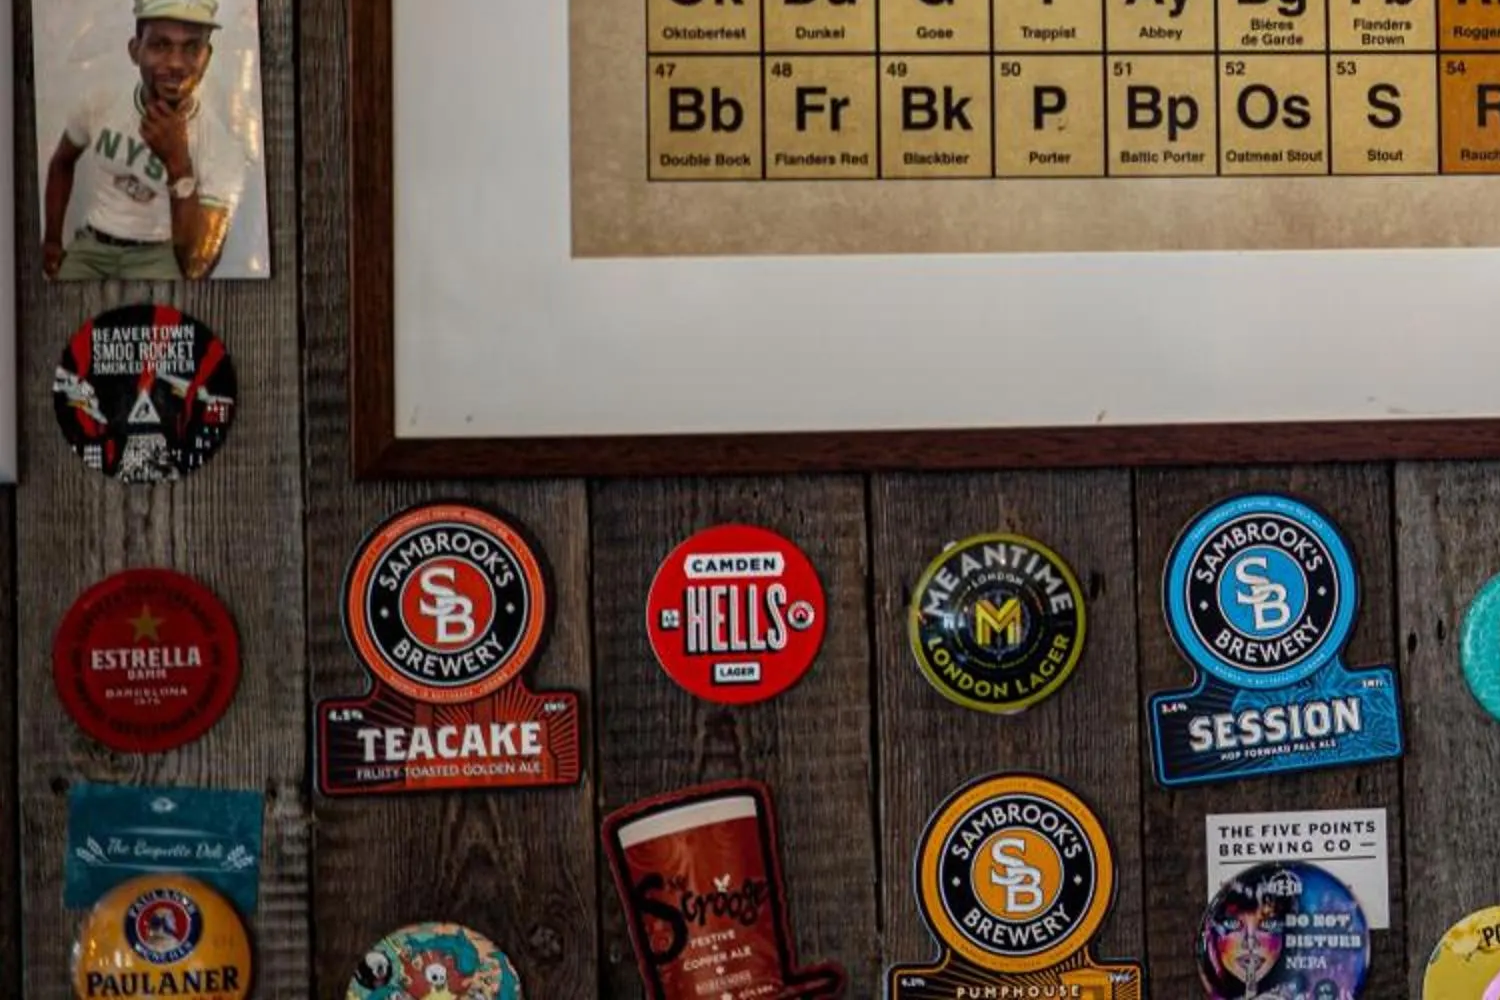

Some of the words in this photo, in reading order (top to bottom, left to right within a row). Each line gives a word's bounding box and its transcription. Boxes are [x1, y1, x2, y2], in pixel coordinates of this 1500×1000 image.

[662, 26, 746, 40] Oktoberfest
[1020, 26, 1076, 42] Trappist
[1353, 18, 1412, 32] Flanders
[1361, 33, 1404, 46] Brown
[655, 62, 676, 78] 47
[1000, 61, 1022, 77] 50
[668, 86, 744, 133] Bb
[1033, 85, 1067, 131] P
[1236, 83, 1312, 130] Os
[660, 153, 711, 167] Double
[715, 152, 751, 167] Bock
[1029, 151, 1071, 164] Porter
[93, 325, 195, 341] BEAVERTOWN
[139, 341, 195, 361] ROCKET
[379, 531, 515, 592] SAMBROOK'S
[1196, 521, 1324, 584] SAMBROOK'S
[692, 557, 776, 573] CAMDEN
[924, 543, 1074, 617] MEANTIME
[686, 583, 788, 653] HELLS
[1215, 615, 1321, 664] BREWERY
[91, 646, 202, 670] ESTRELLA
[392, 632, 504, 678] BREWERY
[719, 666, 755, 678] LAGER
[927, 636, 1010, 699] LONDON
[1015, 634, 1070, 694] LAGER
[105, 684, 188, 699] BARCELONA
[1188, 697, 1362, 752] SESSION
[357, 721, 543, 762] TEACAKE
[357, 764, 400, 781] FRUITY
[404, 763, 459, 778] TOASTED
[462, 762, 516, 777] GOLDEN
[519, 761, 542, 774] ALE
[1218, 826, 1254, 839] THE
[1261, 824, 1301, 837] FIVE
[1309, 821, 1376, 835] POINTS
[1218, 841, 1314, 857] BREWING
[1324, 839, 1351, 852] CO
[86, 966, 240, 998] PAULANER
[956, 984, 1081, 999] PUMPHOUSE
